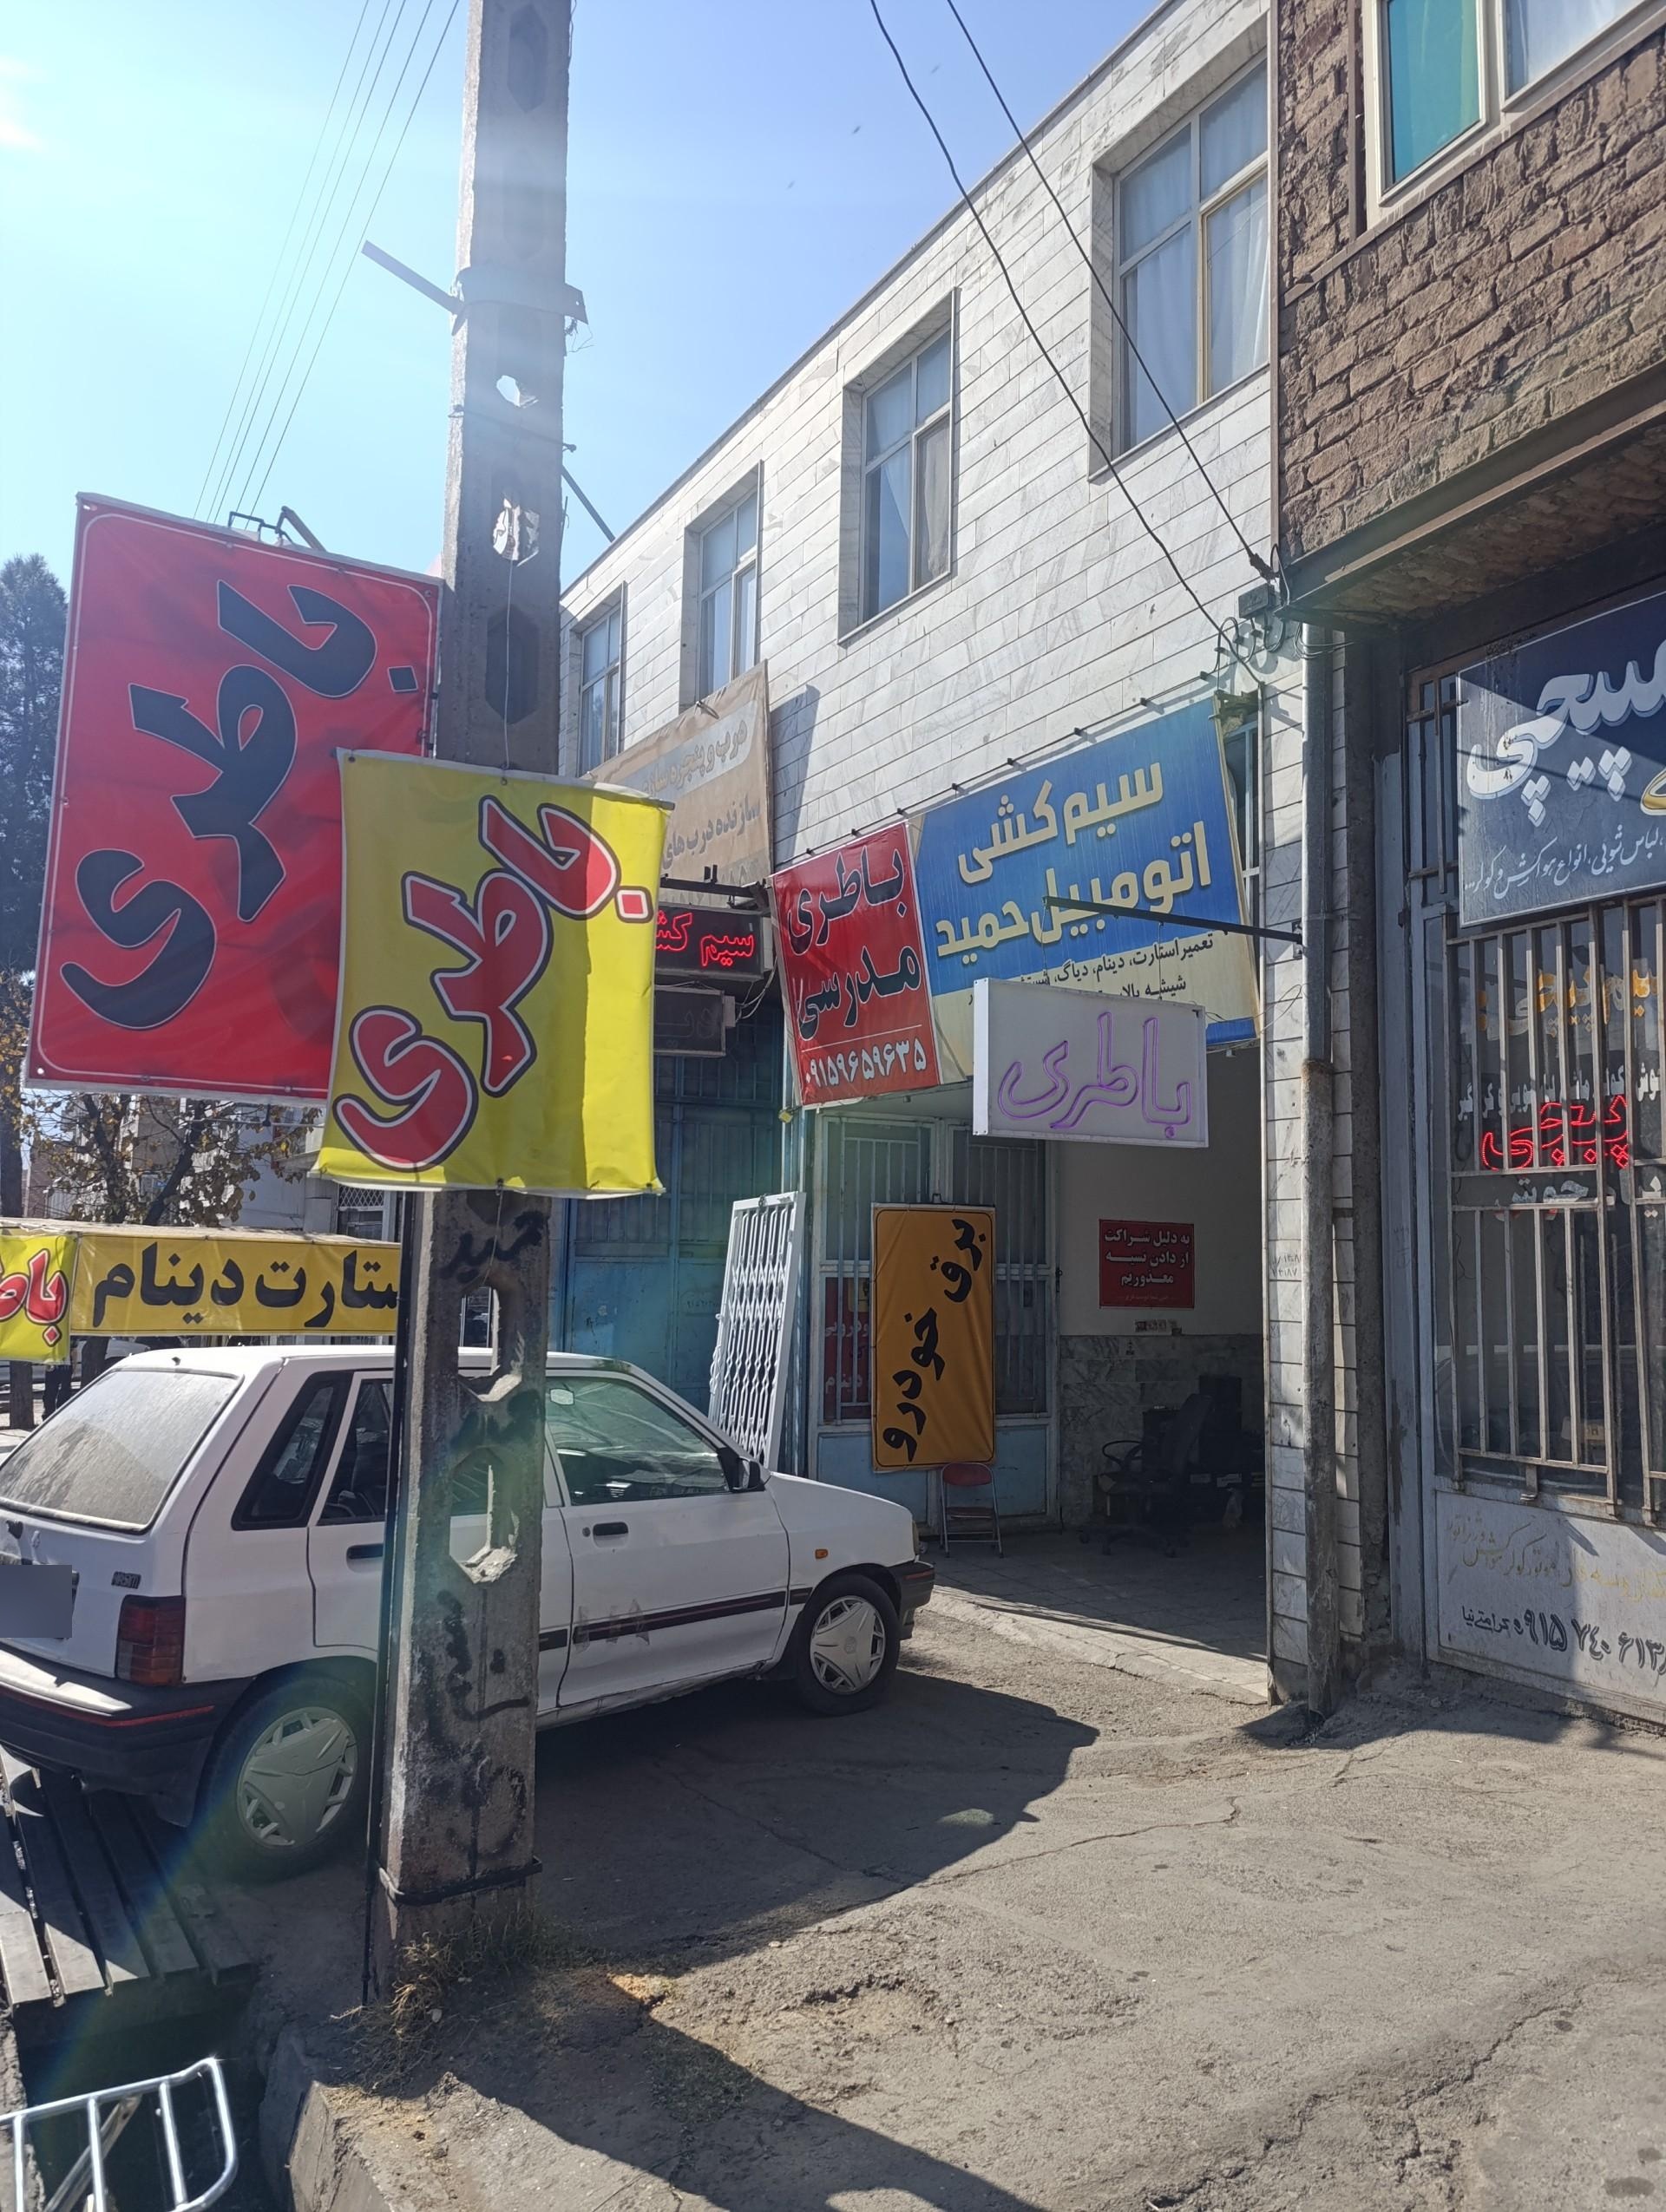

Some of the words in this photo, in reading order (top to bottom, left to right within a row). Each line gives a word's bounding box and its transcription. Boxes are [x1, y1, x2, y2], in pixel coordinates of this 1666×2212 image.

[60, 579, 421, 1029] باطری
[686, 820, 713, 856] درب
[715, 792, 761, 837] سازنده
[788, 846, 904, 956] باطری
[1028, 821, 1211, 944] اتومبیل
[655, 909, 692, 952] کش
[700, 933, 754, 967] سیم
[936, 898, 1030, 964] حمید
[334, 795, 653, 1173] باطری
[791, 946, 922, 1041] مدرسی
[998, 1011, 1192, 1138] باطری
[930, 1219, 987, 1302] برق
[1105, 1249, 1147, 1266] نسیه
[1150, 1249, 1177, 1267] دادن
[1153, 1230, 1177, 1247] دلیل
[1180, 1232, 1190, 1248] به
[92, 1241, 245, 1328] دینام
[254, 1249, 400, 1328] ستارت
[1121, 1269, 1175, 1287] معذوریم
[882, 1307, 945, 1463] خودرو
